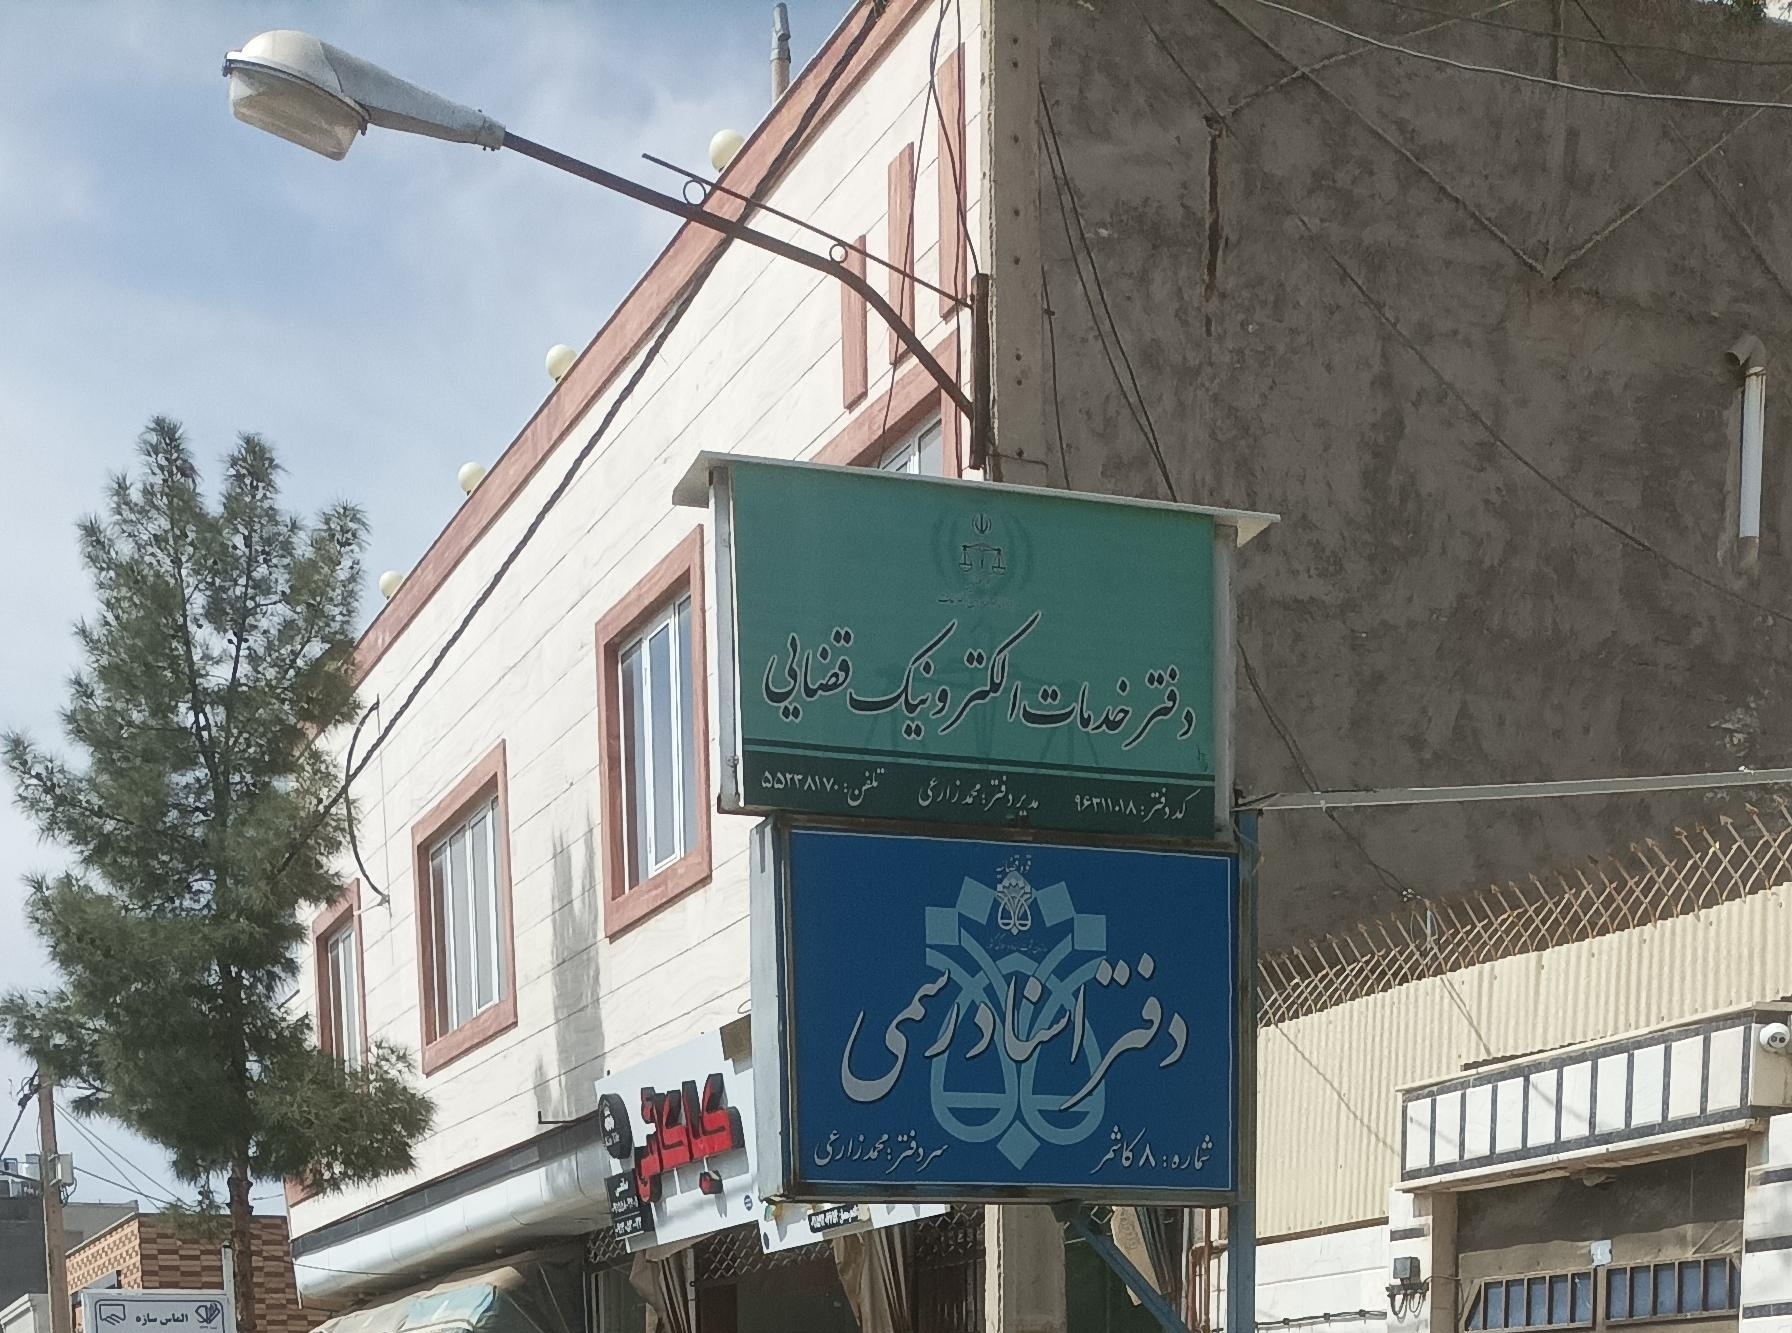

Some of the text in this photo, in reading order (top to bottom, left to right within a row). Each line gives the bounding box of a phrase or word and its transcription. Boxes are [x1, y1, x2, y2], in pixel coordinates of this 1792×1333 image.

[847, 610, 1042, 741] الکترونیک
[1022, 676, 1132, 739] خدمات
[1123, 664, 1196, 751] دفتر
[761, 769, 839, 793] ۵۵۲۳۸۱۷۰
[917, 777, 961, 807] زارعی
[961, 783, 982, 805] محمد
[1015, 793, 1040, 817] مدیر
[1074, 793, 1138, 816] ۹۶۳۱۱۰۱۸
[1170, 787, 1202, 820] کد
[840, 952, 1189, 1111] دفتر اسناد رسمی
[813, 1129, 865, 1167] زارعی
[862, 1133, 889, 1161] محمد
[1089, 1124, 1147, 1175] کاشمر
[1138, 1142, 1157, 1168] ۸
[135, 1312, 189, 1327] الماس سازه
